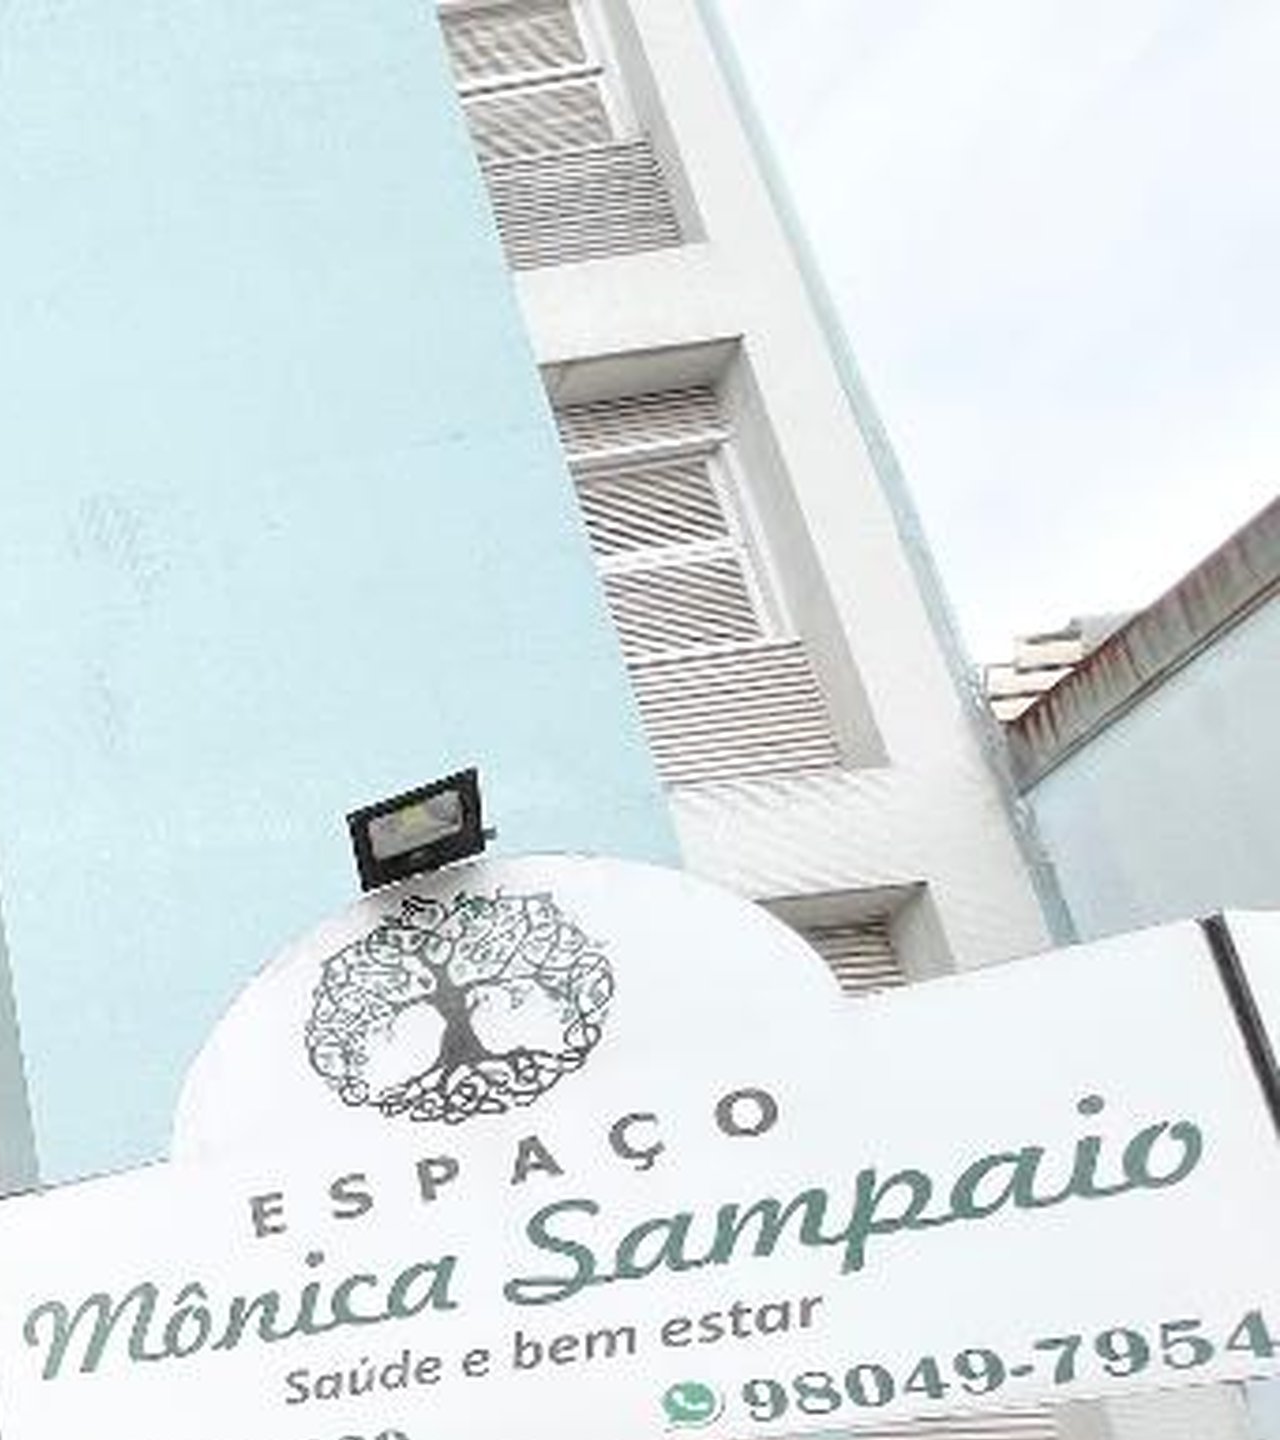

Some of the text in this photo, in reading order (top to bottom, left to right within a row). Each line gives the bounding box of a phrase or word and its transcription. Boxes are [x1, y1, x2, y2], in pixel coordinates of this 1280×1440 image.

[248, 1087, 780, 1239] ESPAÇO
[22, 1094, 1204, 1382] Mônica Sampaio
[285, 1296, 824, 1405] Saúde e bem estar
[741, 1306, 1280, 1423] 98049-7954
